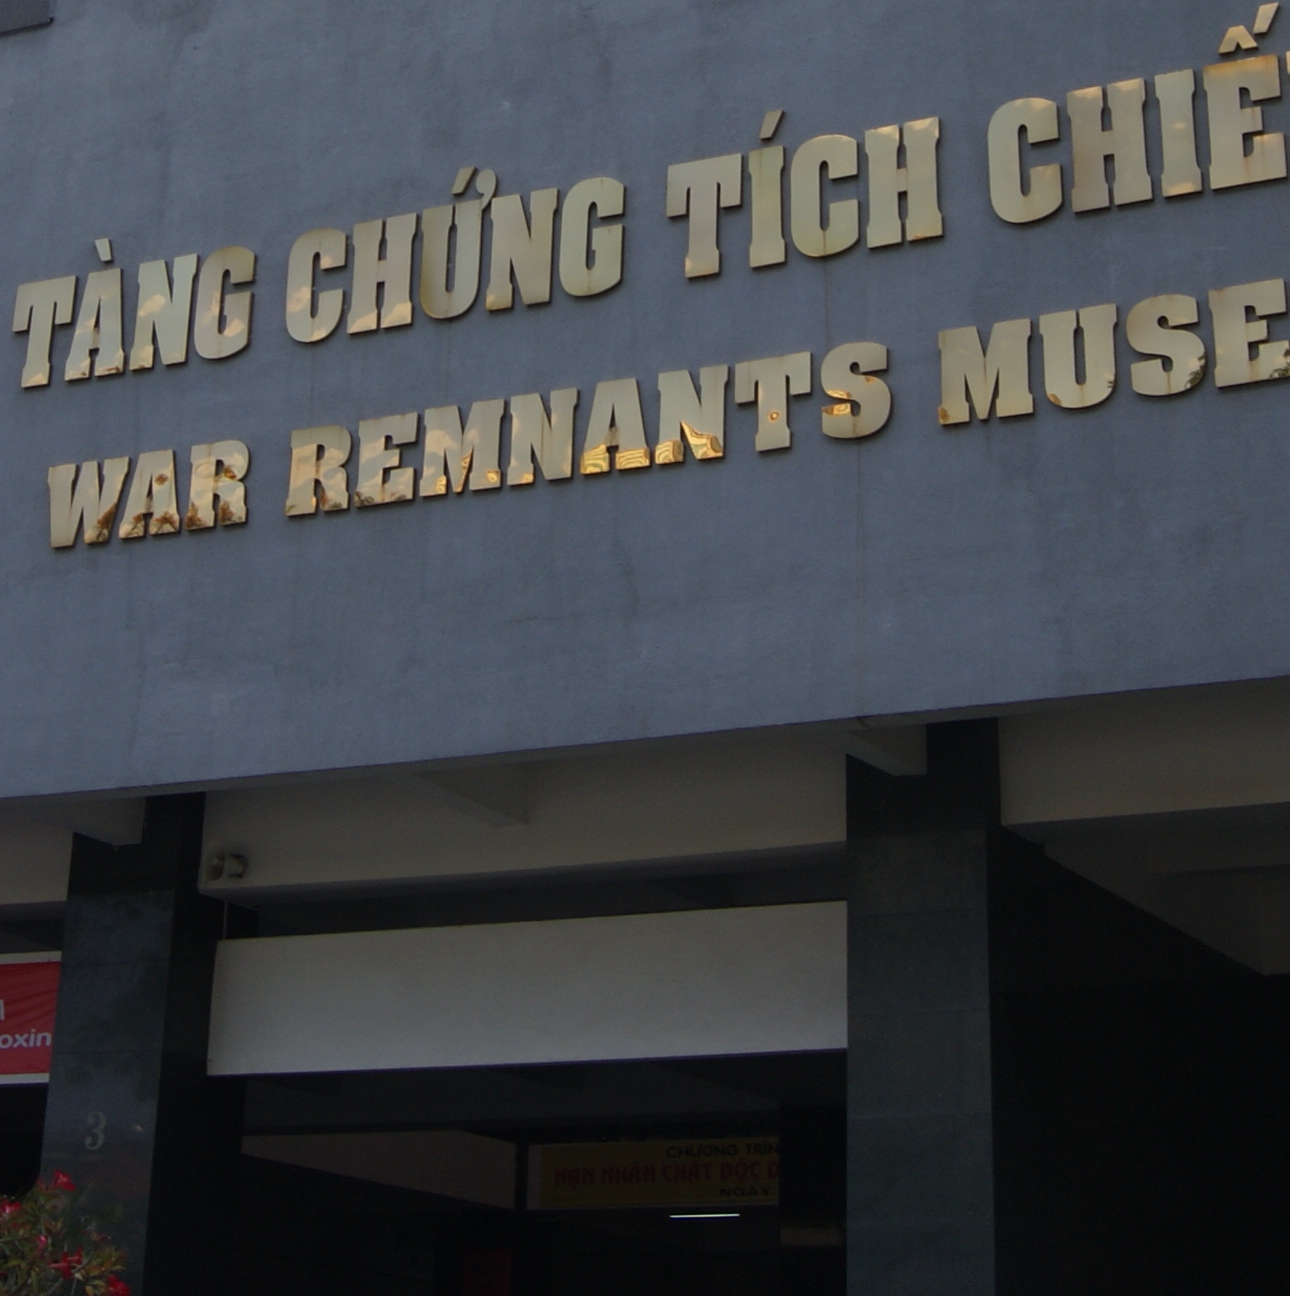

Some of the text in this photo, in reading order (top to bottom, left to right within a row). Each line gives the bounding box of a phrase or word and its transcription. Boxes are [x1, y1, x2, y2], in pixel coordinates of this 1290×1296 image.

[13, 238, 255, 389] TÀNG
[285, 166, 625, 342] CHỨNG
[666, 109, 944, 278] TÍCH
[48, 439, 249, 548] WAR
[285, 341, 891, 516] REMNANTS
[85, 1111, 106, 1150] 3
[745, 1141, 781, 1155] TRÌN
